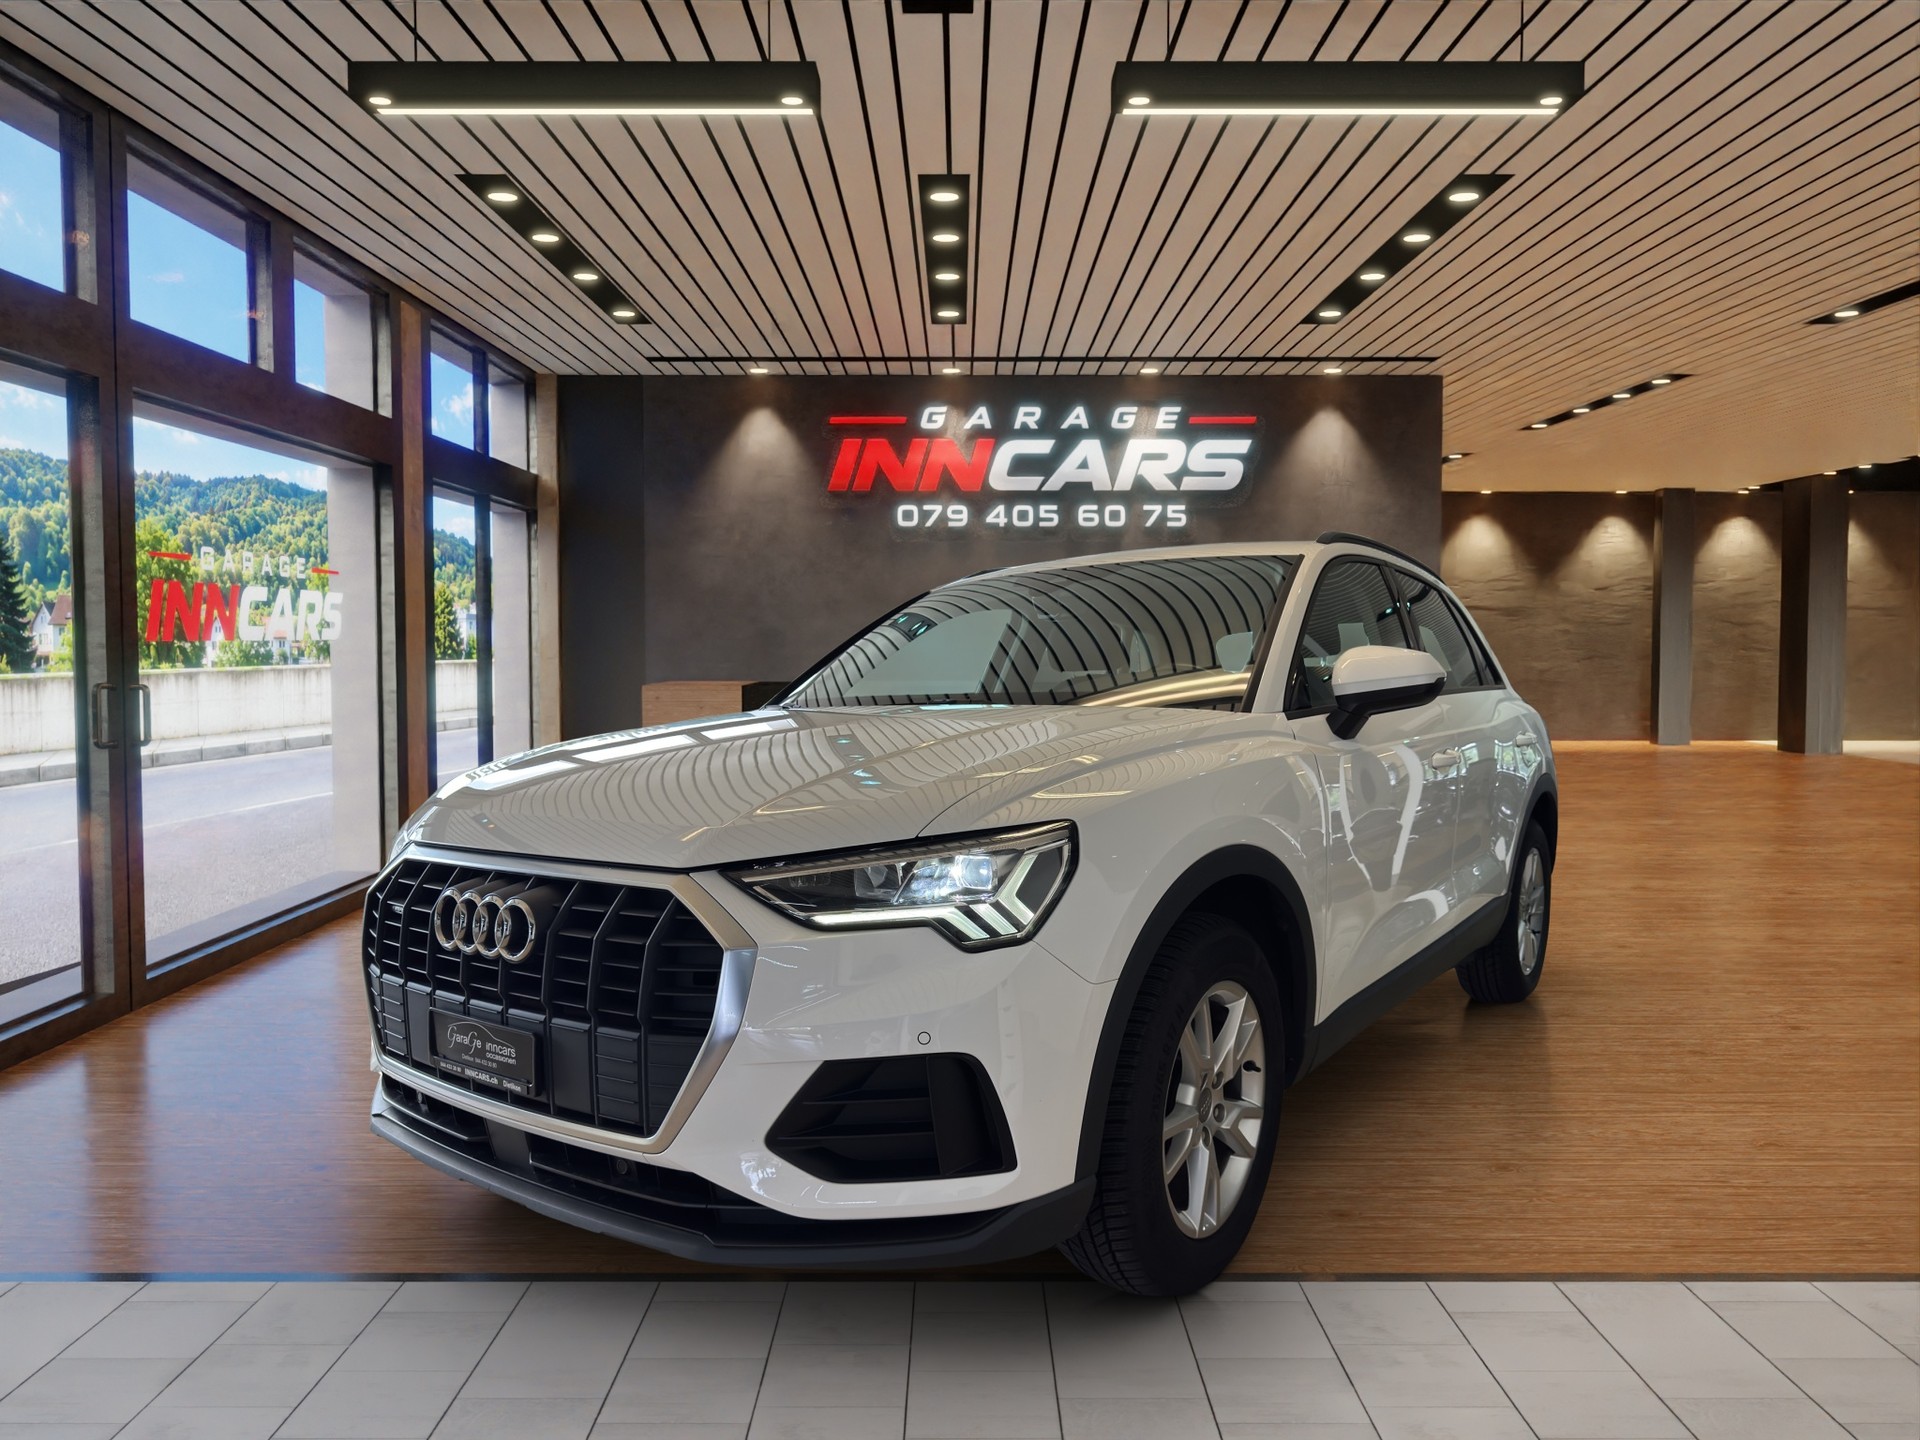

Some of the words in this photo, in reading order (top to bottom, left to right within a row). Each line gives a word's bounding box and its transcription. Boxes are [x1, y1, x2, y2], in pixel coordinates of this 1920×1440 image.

[920, 406, 1182, 430] GARAGE
[827, 438, 1252, 492] INNCARS
[897, 504, 968, 528] 079
[985, 504, 1059, 528] 405
[1077, 504, 1126, 528] 60
[1143, 504, 1187, 528] 75
[200, 546, 306, 579] GARAGE
[145, 578, 343, 642] INNCARS
[485, 1042, 516, 1058] inncars
